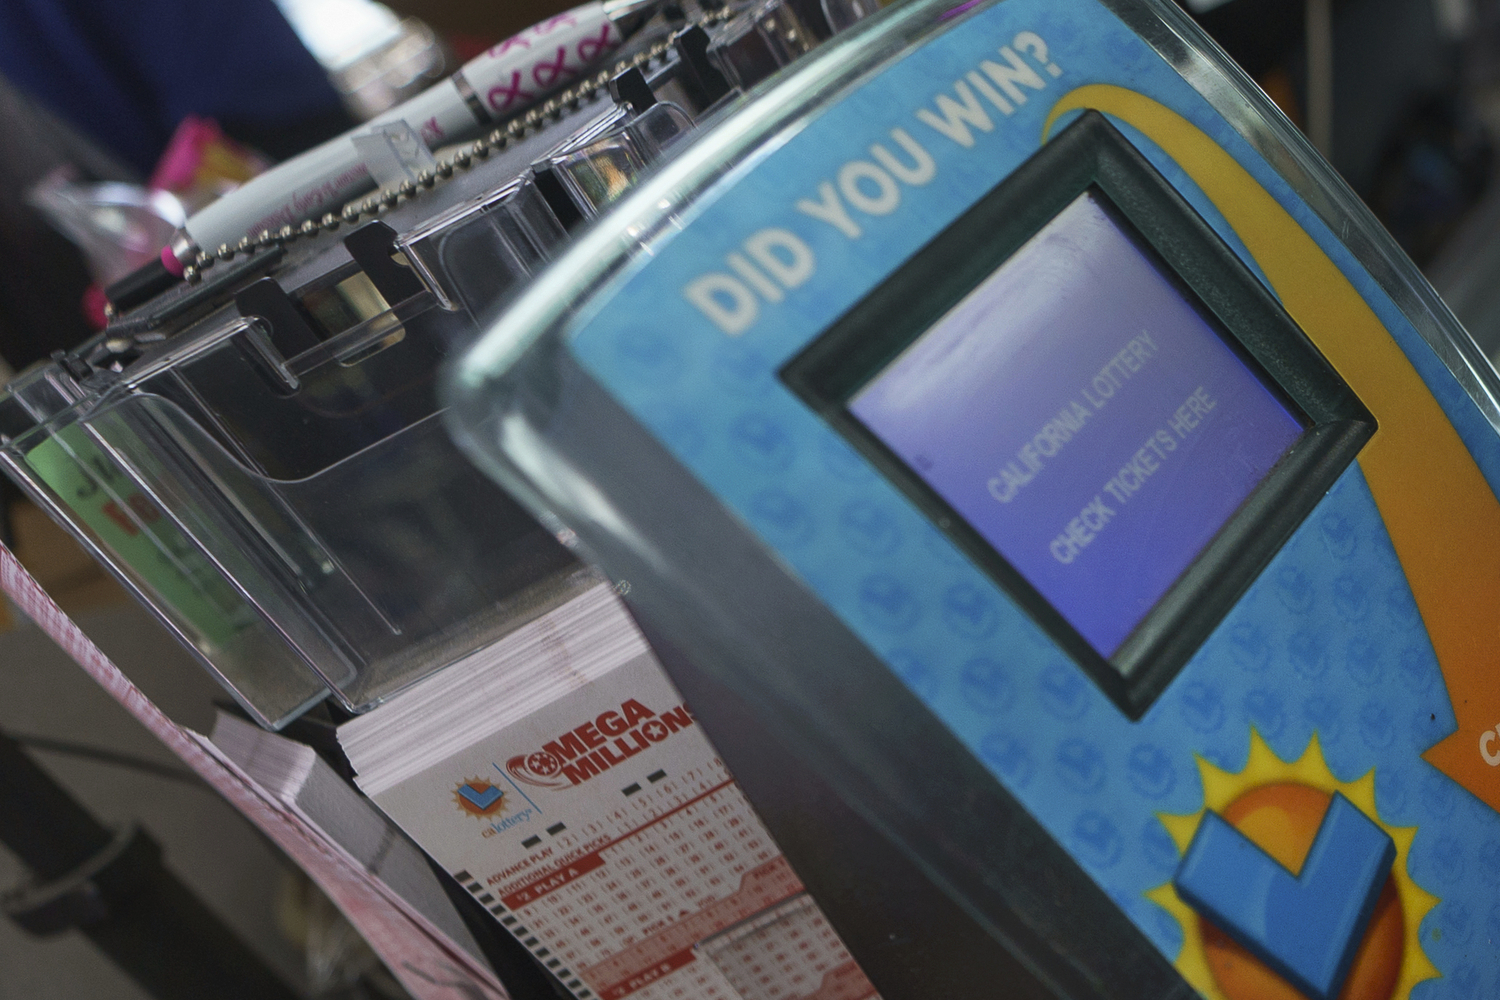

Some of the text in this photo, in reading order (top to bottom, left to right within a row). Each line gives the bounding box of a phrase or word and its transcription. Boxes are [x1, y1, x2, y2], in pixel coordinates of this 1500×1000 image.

[682, 32, 1064, 338] DID YOU WIN?
[986, 328, 1159, 502] CALIFORNIA LOTTERY
[1049, 385, 1217, 564] CHECK TICKETS HERE
[541, 697, 656, 765] MEGA
[486, 857, 532, 885] ADVANCE
[529, 847, 553, 864] PLAY
[497, 861, 555, 897] ADDITIONAL
[553, 846, 585, 868] QUICK
[582, 833, 611, 852] PICKS
[534, 872, 566, 894] PLAY
[567, 866, 579, 877] A
